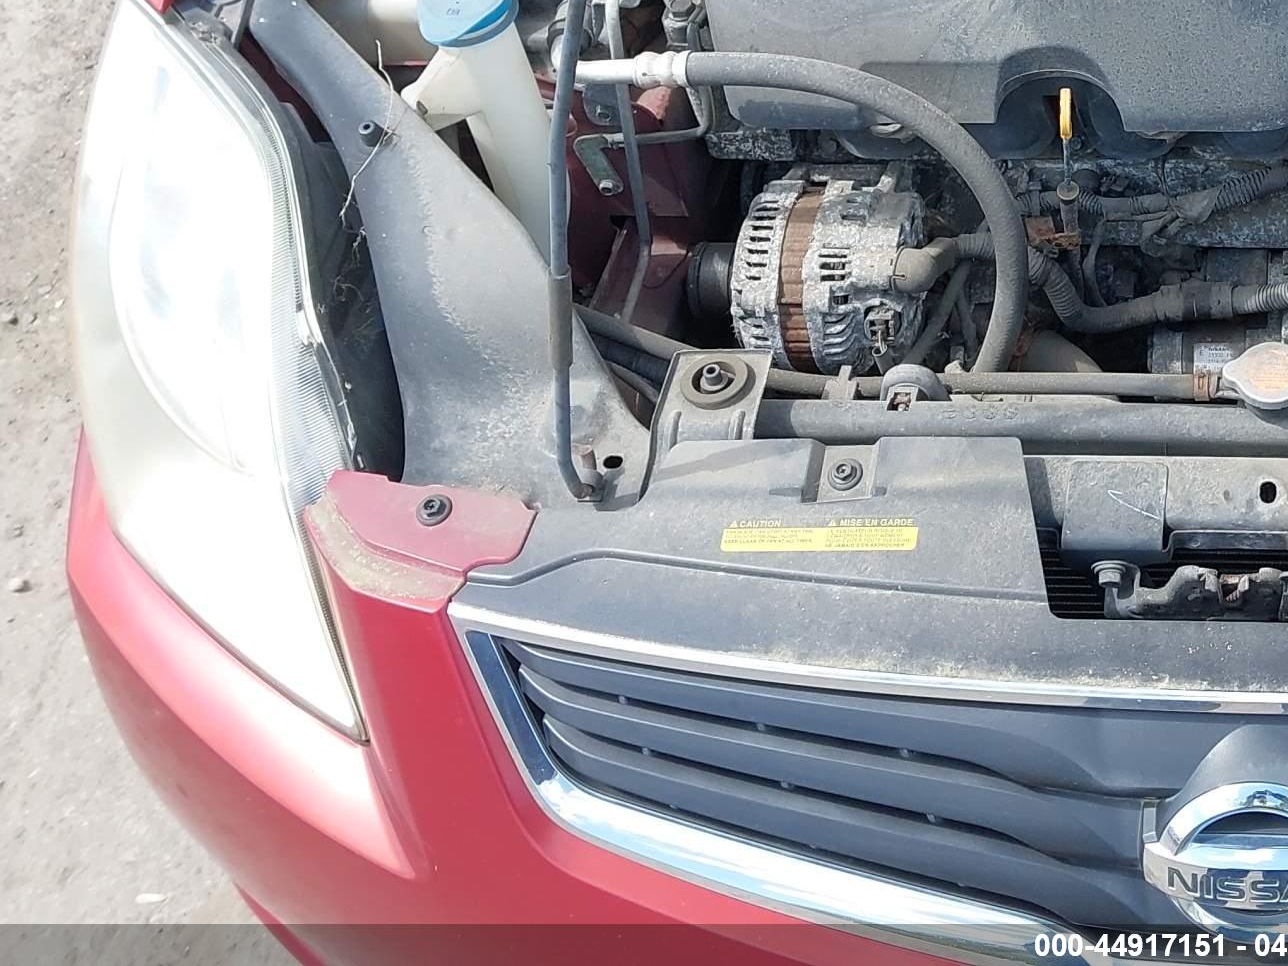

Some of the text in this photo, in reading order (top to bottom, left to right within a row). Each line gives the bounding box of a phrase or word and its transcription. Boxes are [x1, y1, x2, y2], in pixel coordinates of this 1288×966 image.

[739, 519, 782, 528] CAUTION
[839, 518, 914, 527] MISE EN GARDE
